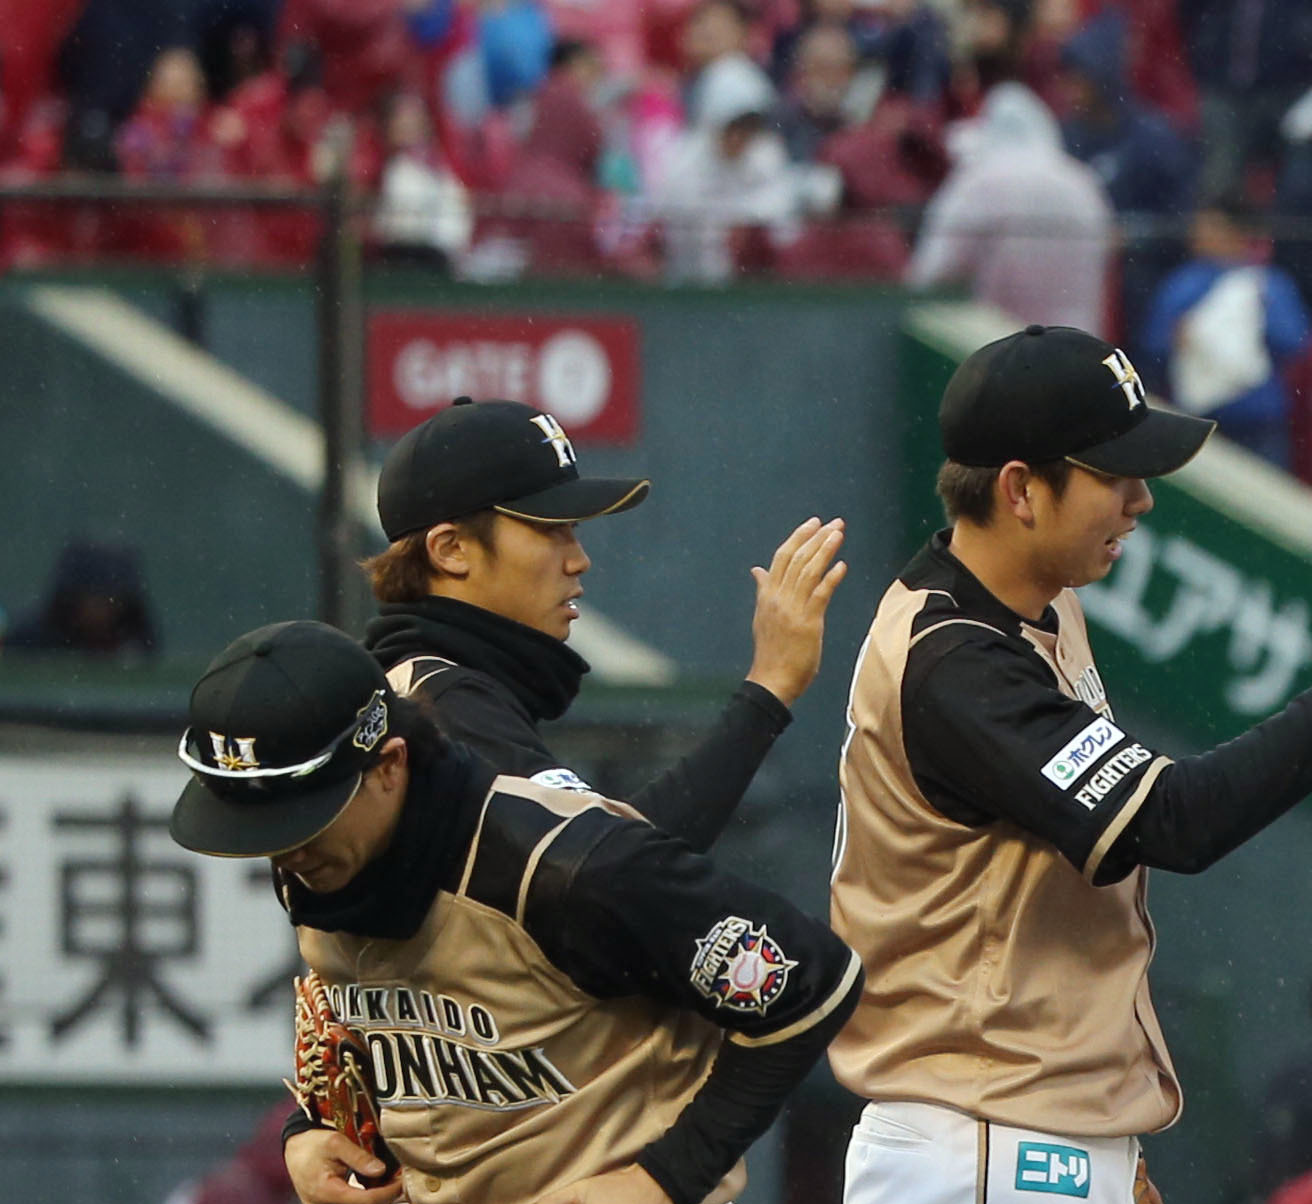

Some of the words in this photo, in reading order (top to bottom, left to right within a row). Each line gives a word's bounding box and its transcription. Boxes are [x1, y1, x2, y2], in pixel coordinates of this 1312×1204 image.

[1067, 725, 1113, 768] ホクレン
[1073, 742, 1153, 812] FIGHTERS
[696, 919, 750, 994] FIGHTERS
[324, 984, 500, 1045] OKKAIDO
[1022, 1150, 1088, 1188] ニトリ
